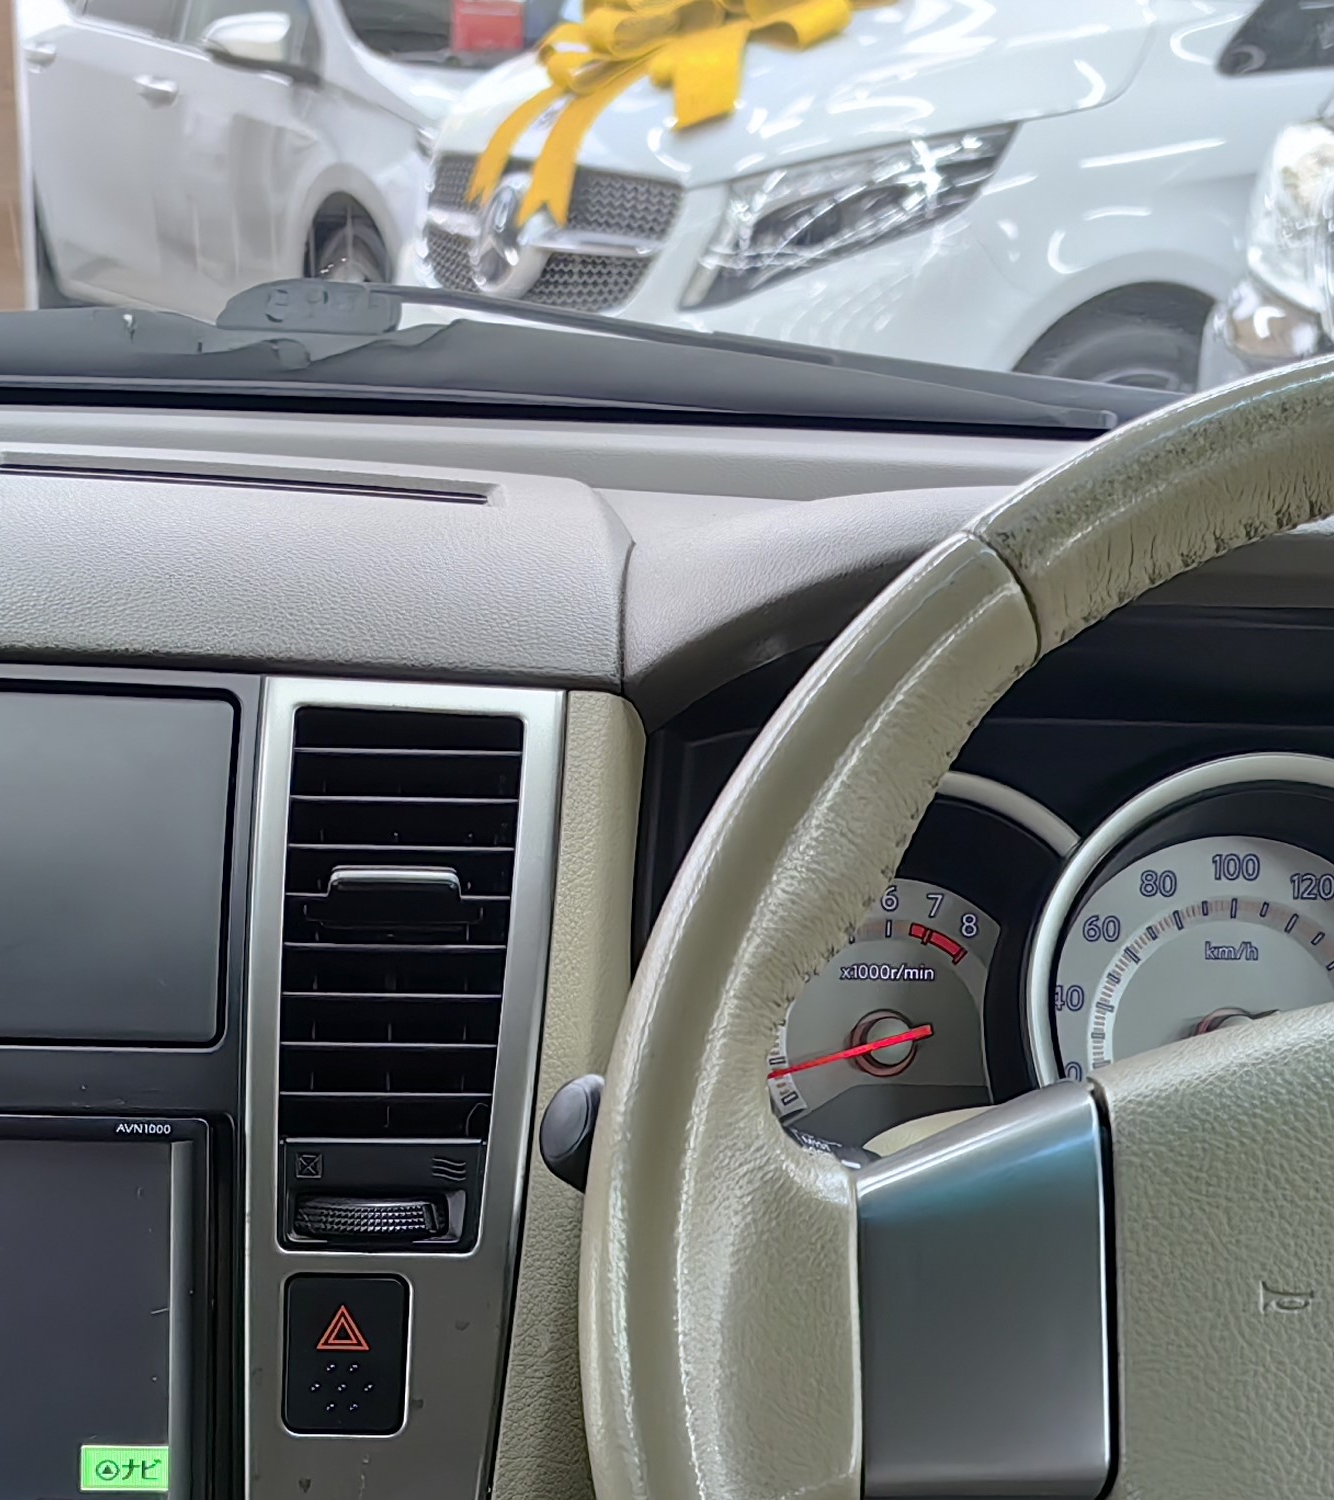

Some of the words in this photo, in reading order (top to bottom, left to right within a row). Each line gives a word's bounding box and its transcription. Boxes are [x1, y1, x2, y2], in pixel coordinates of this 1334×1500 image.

[1212, 853, 1260, 881] 100
[1139, 870, 1177, 898] 80
[880, 885, 899, 912] 6
[926, 894, 945, 919] 7
[960, 913, 980, 938] 8
[1082, 915, 1121, 942] 60
[1204, 941, 1260, 961] km/h
[115, 1122, 172, 1136] AVN1000
[121, 1458, 162, 1481] ナビ
